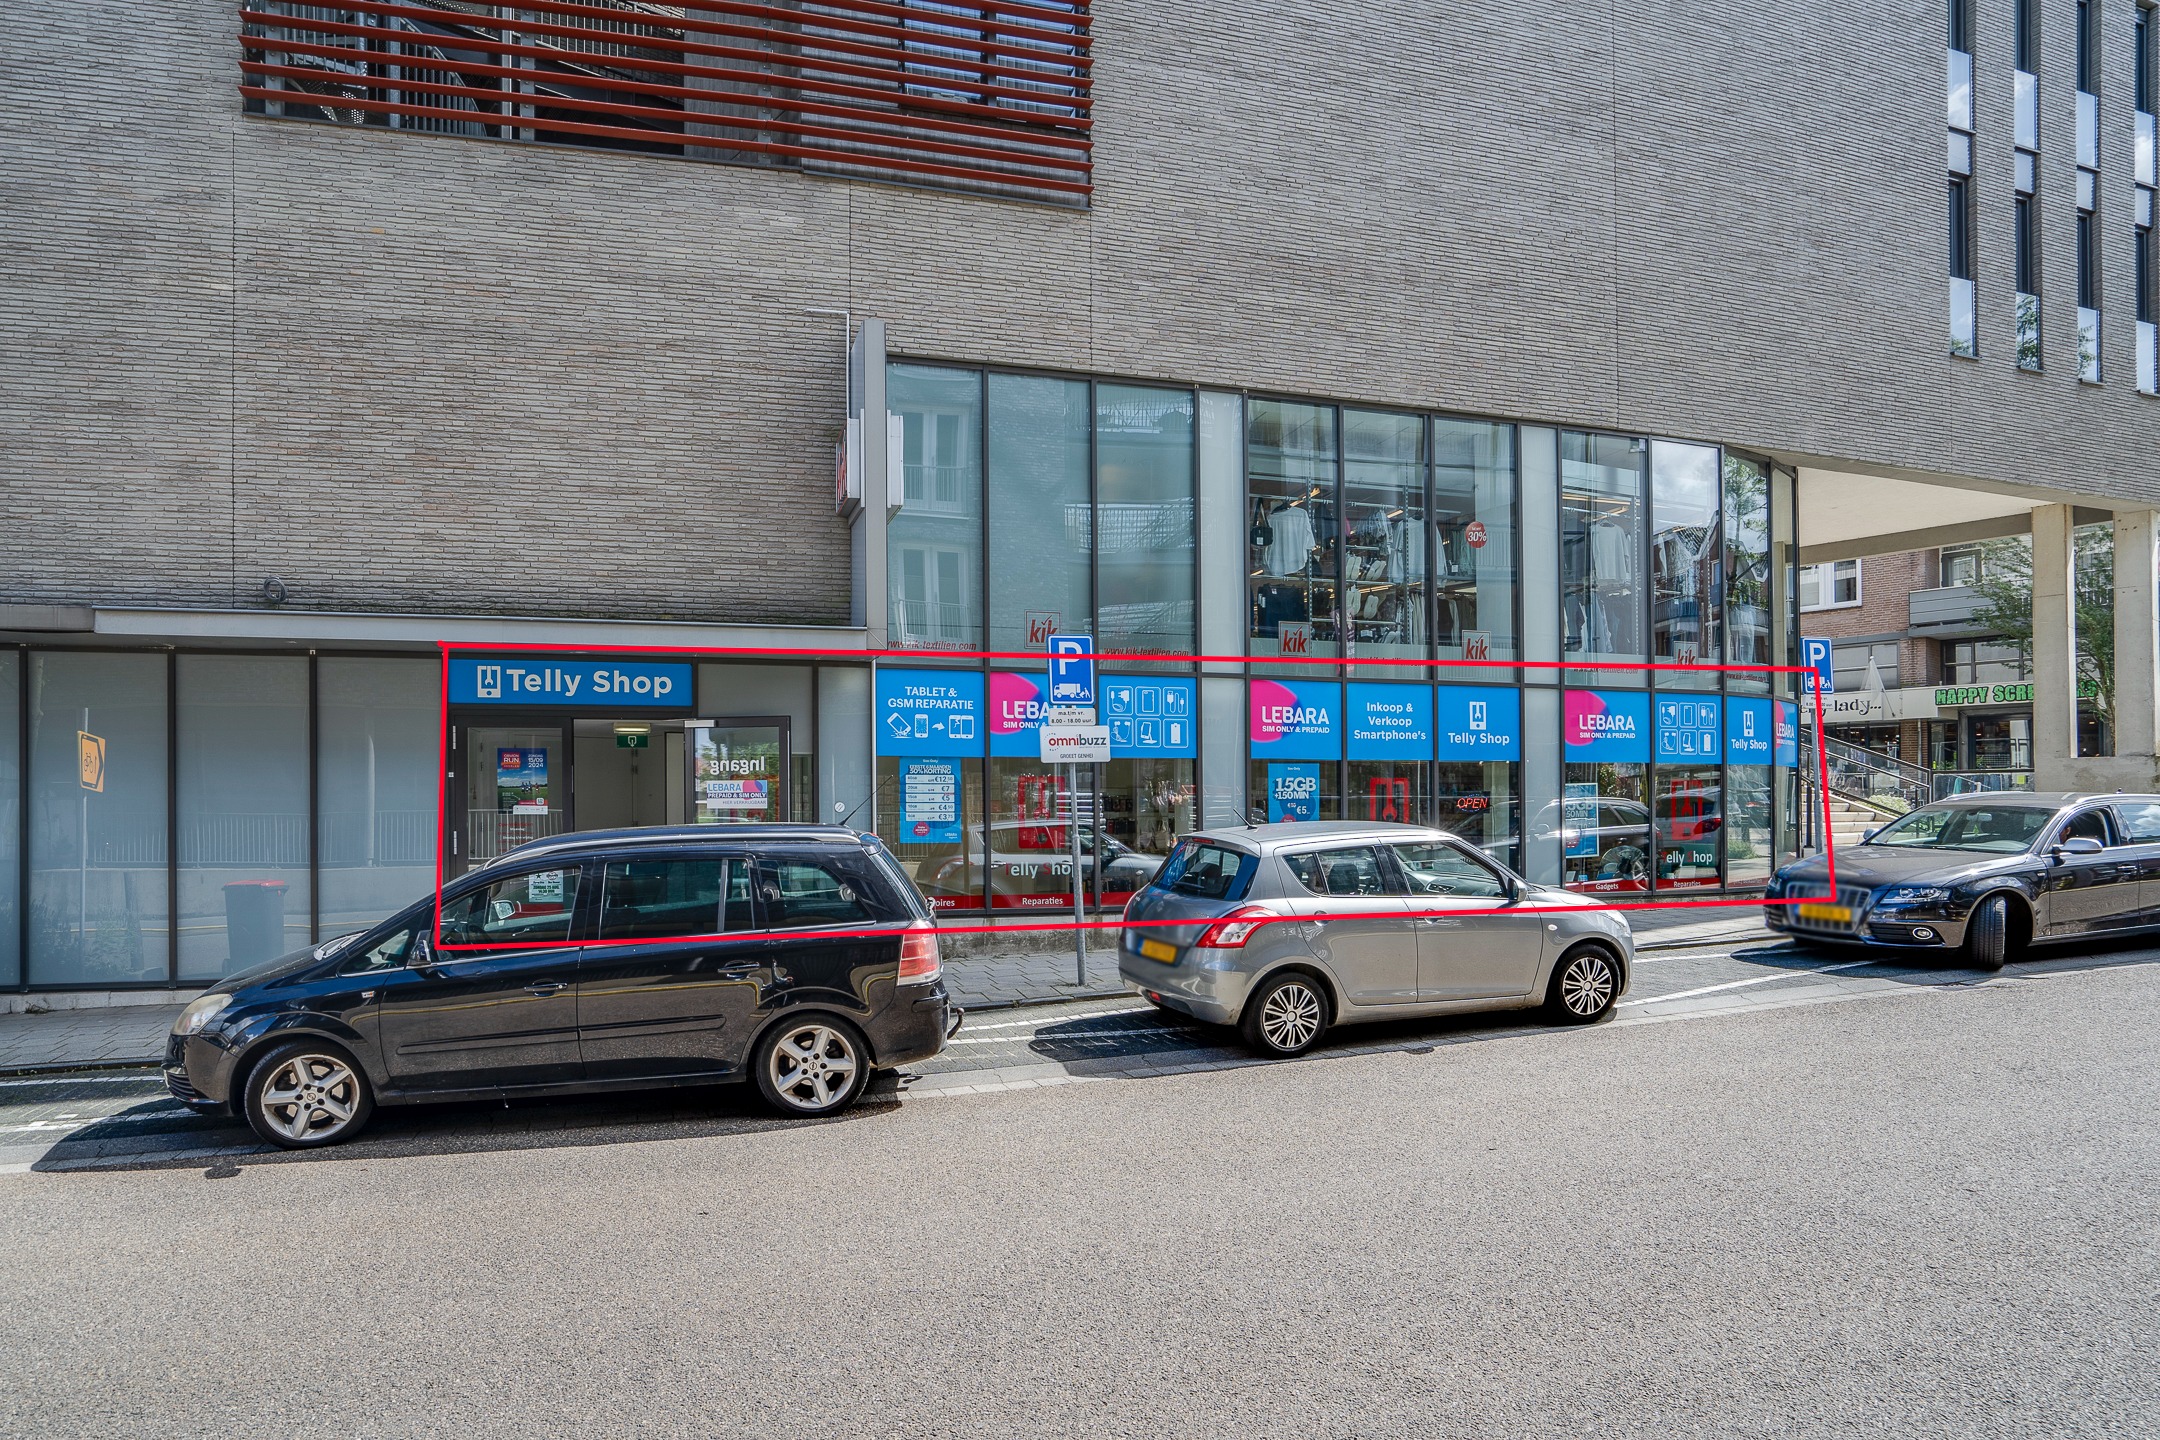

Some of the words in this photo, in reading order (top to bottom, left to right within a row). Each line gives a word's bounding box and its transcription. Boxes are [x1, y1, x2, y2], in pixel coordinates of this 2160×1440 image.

[1468, 531, 1487, 542] 30%
[1029, 615, 1058, 643] kik
[1282, 626, 1308, 653] kik
[1466, 635, 1488, 660] kik
[1058, 641, 1083, 675] P
[1809, 643, 1826, 668] P
[506, 668, 582, 697] Telly
[592, 670, 673, 698] Shop
[905, 686, 946, 697] TABLET
[948, 688, 958, 697] &
[1935, 687, 1989, 705] HAPPY
[888, 698, 914, 708] GSM
[915, 699, 974, 710] REPARATIE
[1366, 702, 1403, 714] Inkoop
[1405, 703, 1414, 713] &
[1262, 706, 1330, 725] LEBARA
[1368, 716, 1412, 727] Verkoop
[1003, 721, 1018, 729] SIM
[1019, 721, 1040, 729] ONLY
[1579, 714, 1636, 731] LEBARA
[1302, 726, 1330, 734] PREPAID
[1354, 730, 1426, 741] Smartphone's
[1776, 722, 1795, 738] LEBARA
[1048, 733, 1107, 747] omnibuzz
[1448, 732, 1476, 746] Telly
[1480, 732, 1510, 746] Shop
[1731, 738, 1748, 751] Telly
[1749, 739, 1768, 751] Shop
[708, 783, 742, 792] LEBARA
[1275, 777, 1317, 792] 15GB
[1274, 791, 1293, 800] +150
[1293, 791, 1309, 799] MIN
[1456, 797, 1488, 809] OPEN
[1662, 851, 1685, 867] Telly
[1687, 850, 1713, 866] Shop
[1005, 861, 1038, 879] Telly
[1596, 883, 1619, 891] Gadgets
[1674, 881, 1702, 889] Reparaties
[1022, 897, 1063, 906] Reparaties
